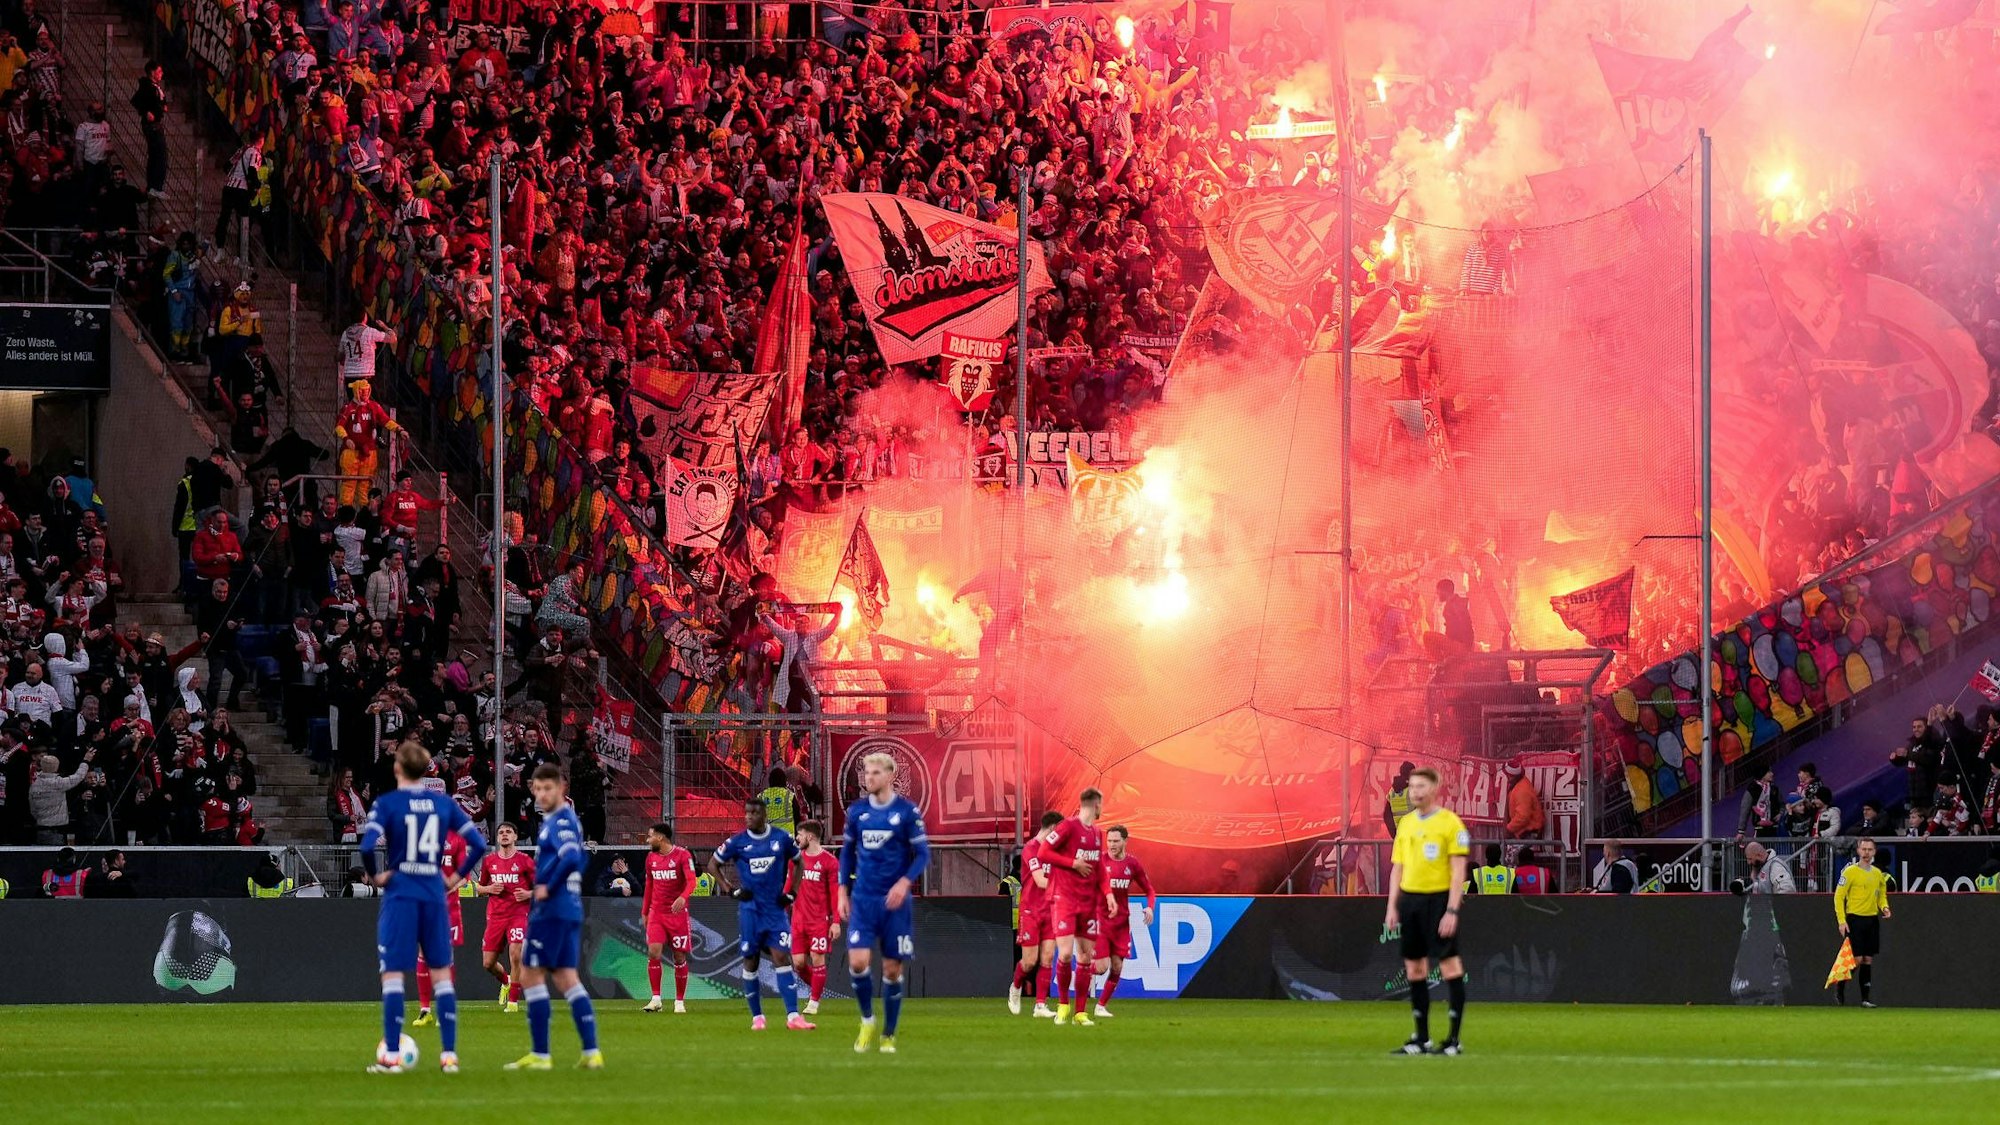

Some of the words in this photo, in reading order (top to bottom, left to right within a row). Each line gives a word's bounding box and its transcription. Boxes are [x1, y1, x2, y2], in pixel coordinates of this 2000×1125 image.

[6, 337, 26, 347] Zero
[27, 338, 57, 348] Waste.
[951, 335, 1003, 359] RAFIKIS
[347, 341, 364, 358] 14
[5, 351, 27, 360] Alles
[28, 352, 59, 360] andere
[61, 351, 72, 361] ist
[73, 352, 95, 362] Müll.
[669, 470, 691, 498] EAT
[692, 467, 716, 480] THE
[1301, 816, 1342, 831] Aren
[404, 814, 440, 863] 14
[1075, 848, 1099, 861] REWE
[751, 858, 772, 869] SAP
[491, 873, 519, 884] REWE
[652, 869, 677, 880] REWE
[1110, 878, 1130, 889] EWE
[1087, 919, 1100, 935] 21
[510, 928, 524, 940] 35
[672, 935, 688, 949] 37
[811, 937, 827, 950] 29
[898, 935, 914, 954] 16
